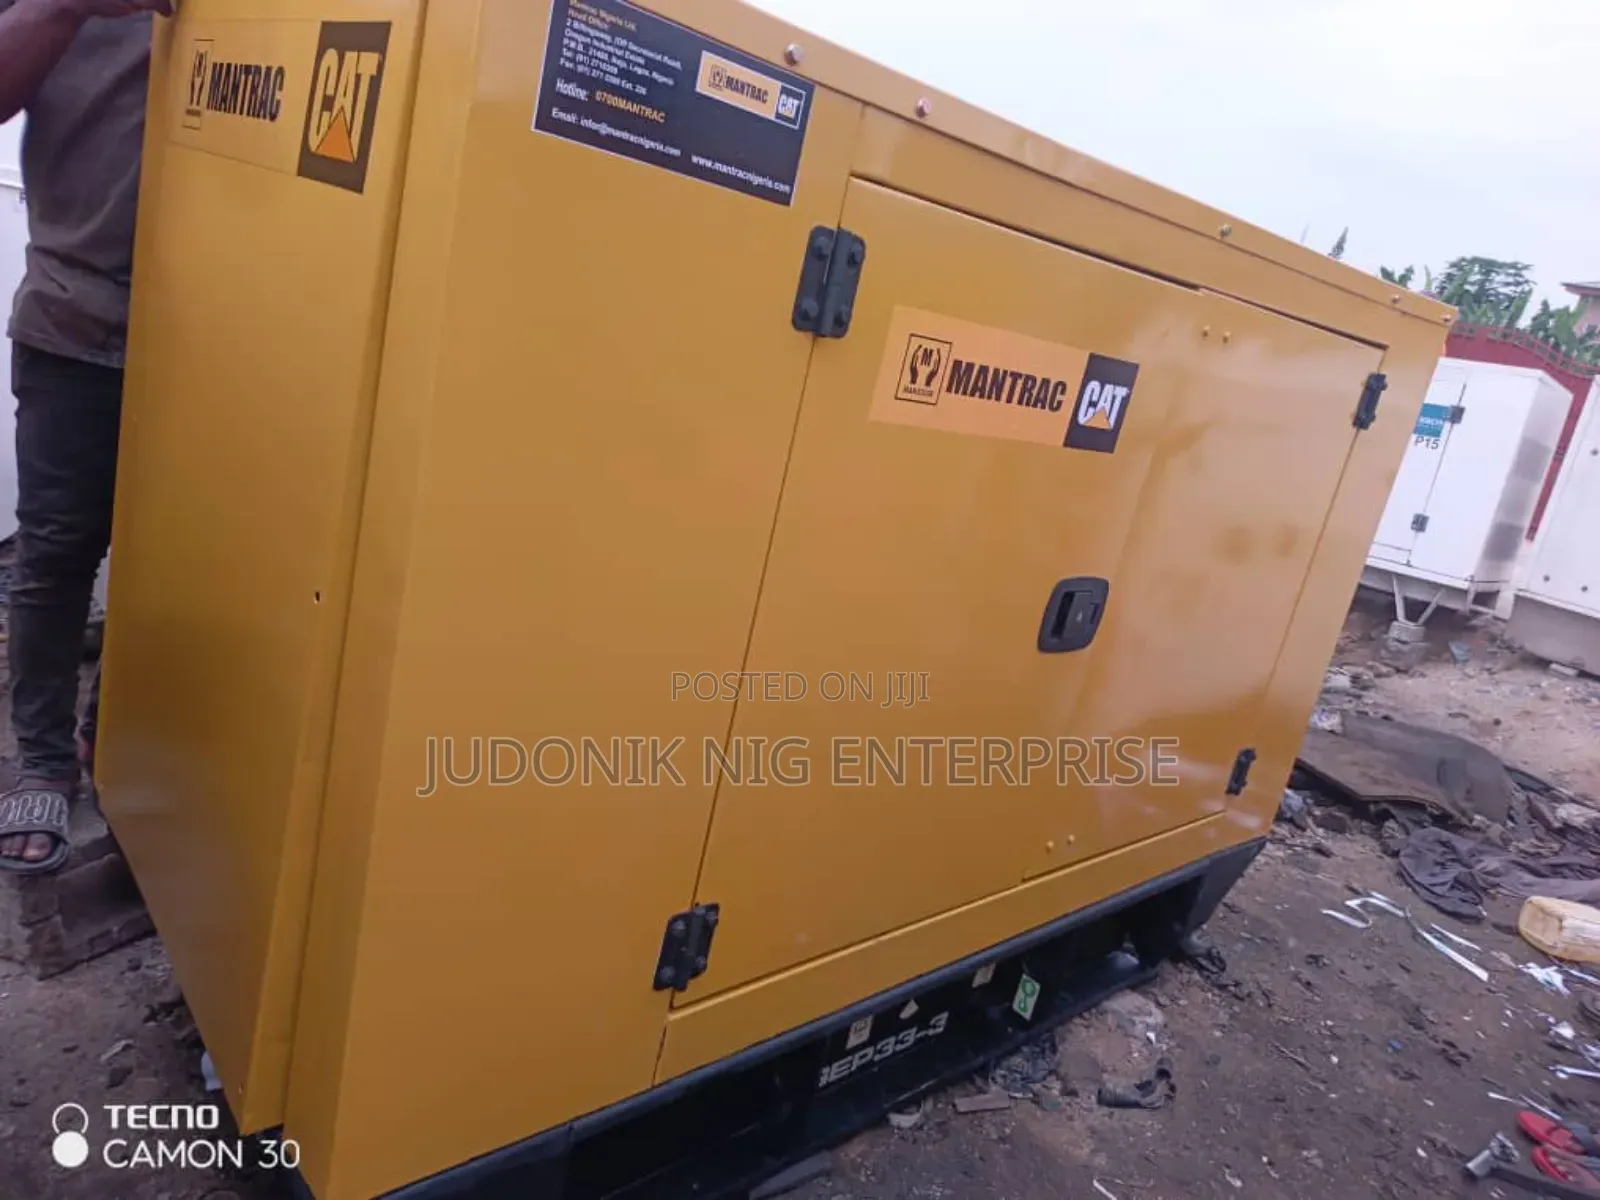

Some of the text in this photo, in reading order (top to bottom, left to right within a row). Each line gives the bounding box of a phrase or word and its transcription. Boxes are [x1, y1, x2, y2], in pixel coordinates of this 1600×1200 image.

[206, 62, 285, 122] MANTRAC
[308, 48, 380, 164] CAT
[724, 75, 769, 104] MANTRAC
[946, 359, 1067, 413] MANTRAC
[1077, 379, 1129, 430] CAT
[1414, 435, 1441, 450] P15
